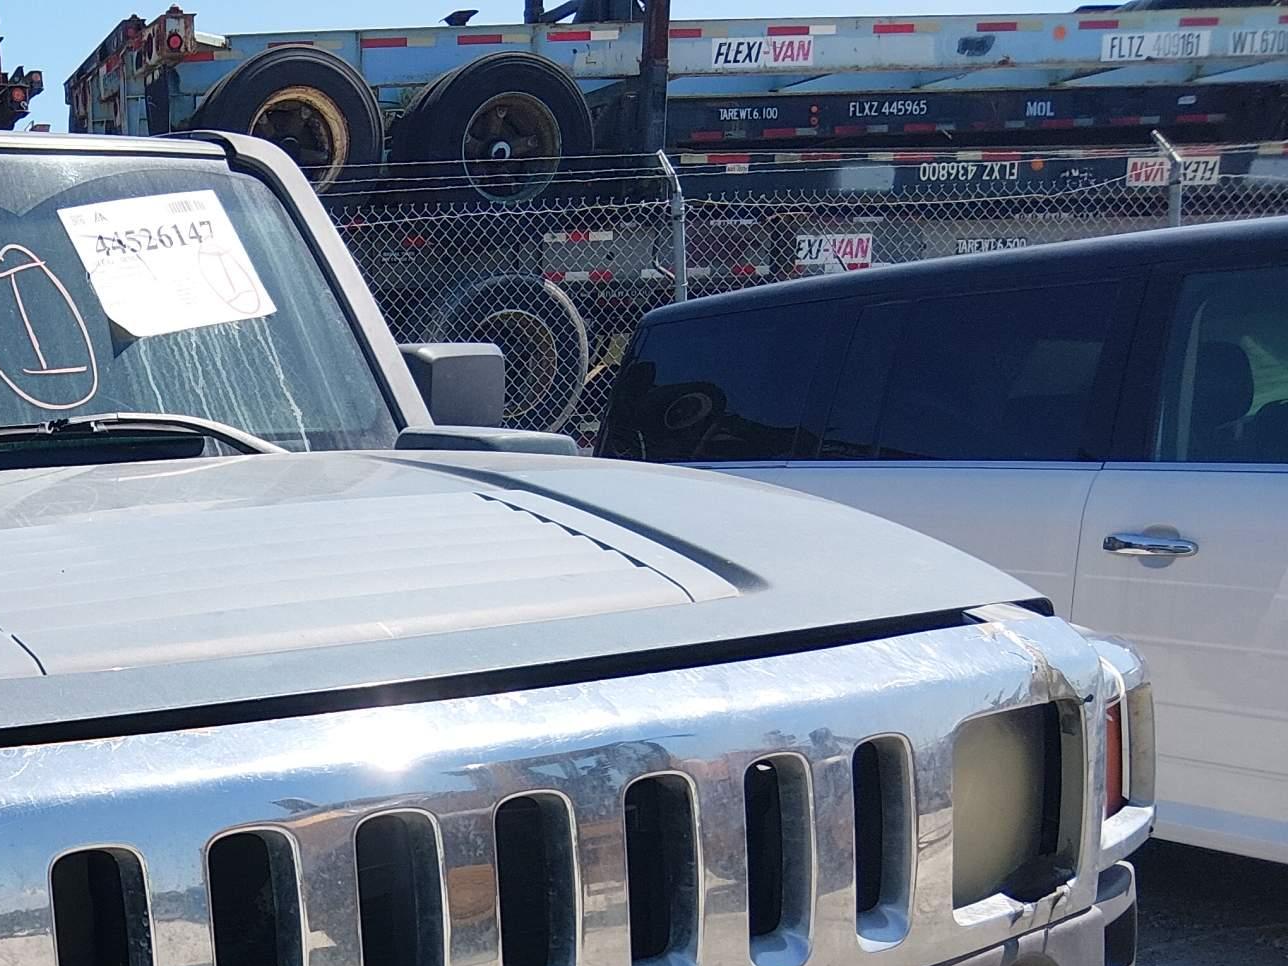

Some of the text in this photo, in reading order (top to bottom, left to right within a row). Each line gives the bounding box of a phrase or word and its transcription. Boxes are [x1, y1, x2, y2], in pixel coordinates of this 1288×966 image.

[714, 40, 812, 65] FLEXI-VAN
[1109, 35, 1145, 58] FLTZ
[849, 99, 927, 117] FLXZ 445965
[1026, 101, 1055, 117] MOL
[919, 160, 1018, 181] FLXZ 436800
[95, 220, 214, 256] 44526147
